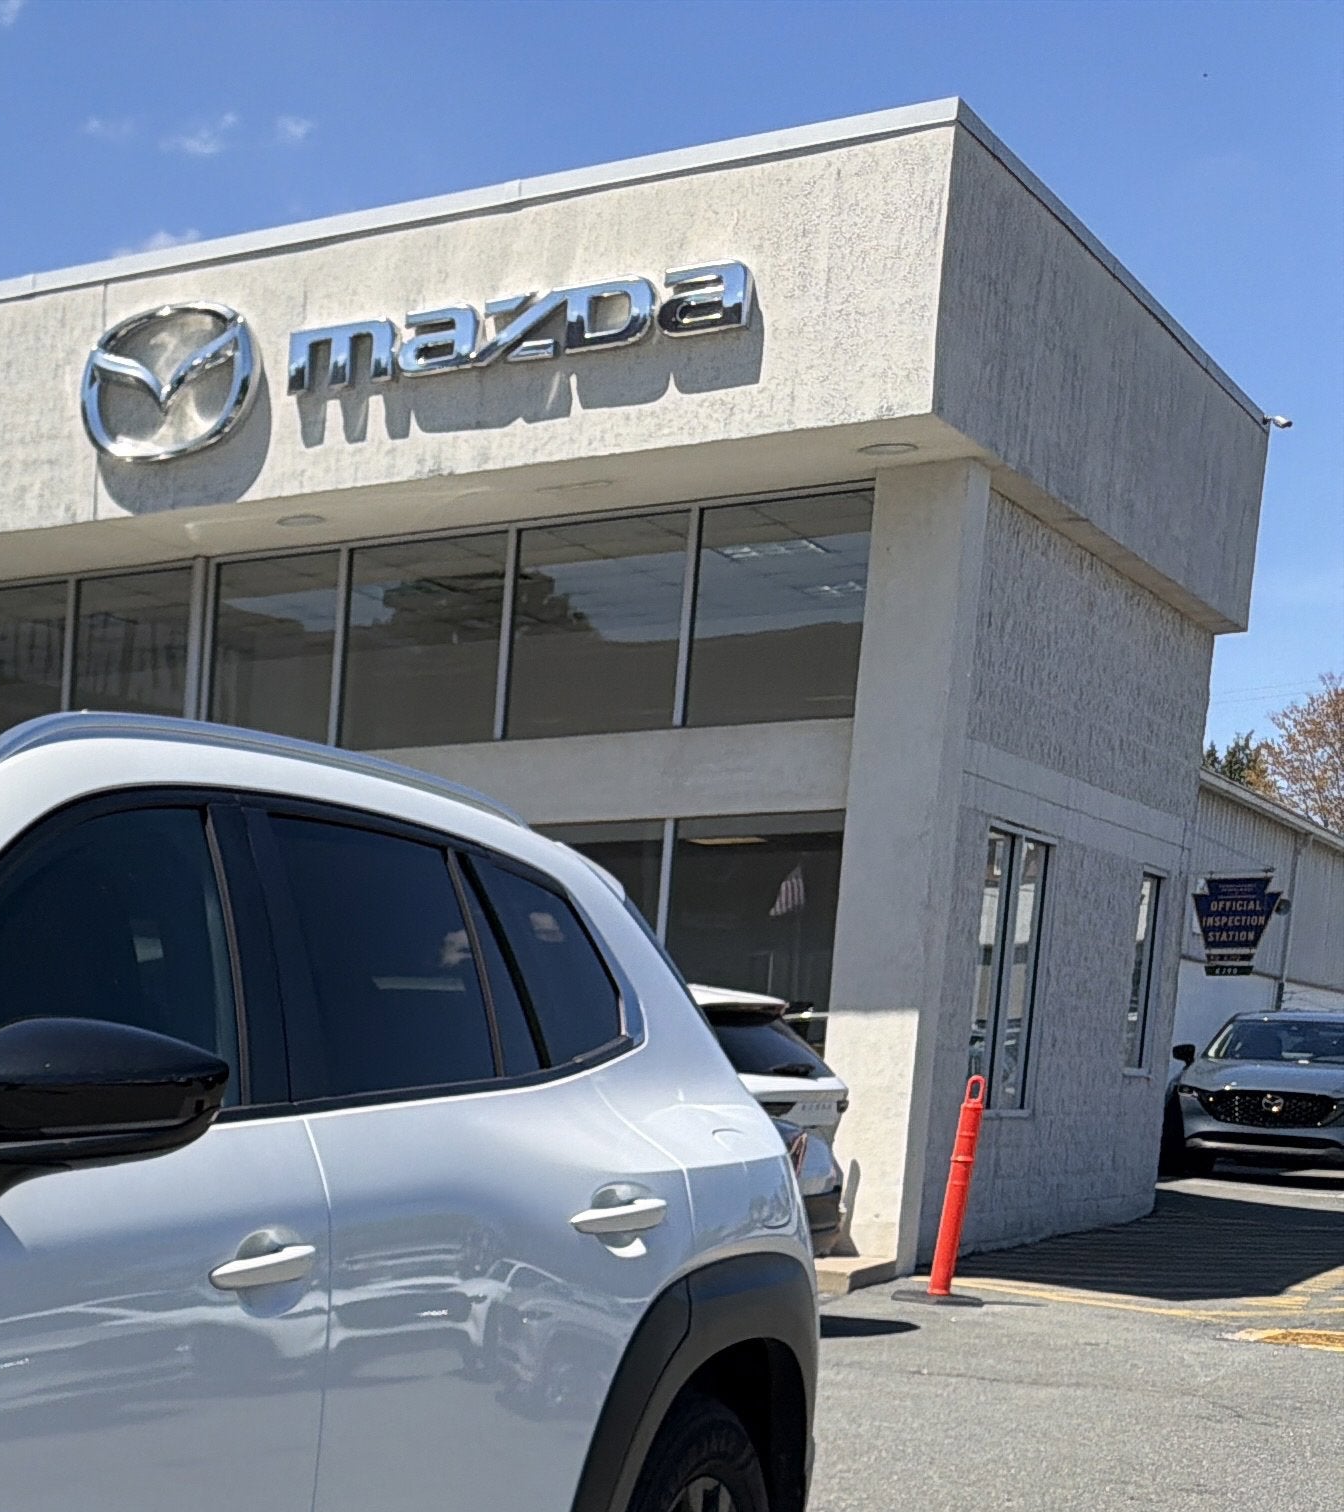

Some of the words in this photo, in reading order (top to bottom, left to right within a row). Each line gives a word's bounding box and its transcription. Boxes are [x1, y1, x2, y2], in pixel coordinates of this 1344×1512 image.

[287, 258, 754, 396] mazda
[1211, 900, 1262, 911] OFFICIAL
[1202, 916, 1265, 927] INSPECTION
[1207, 931, 1255, 942] STATION
